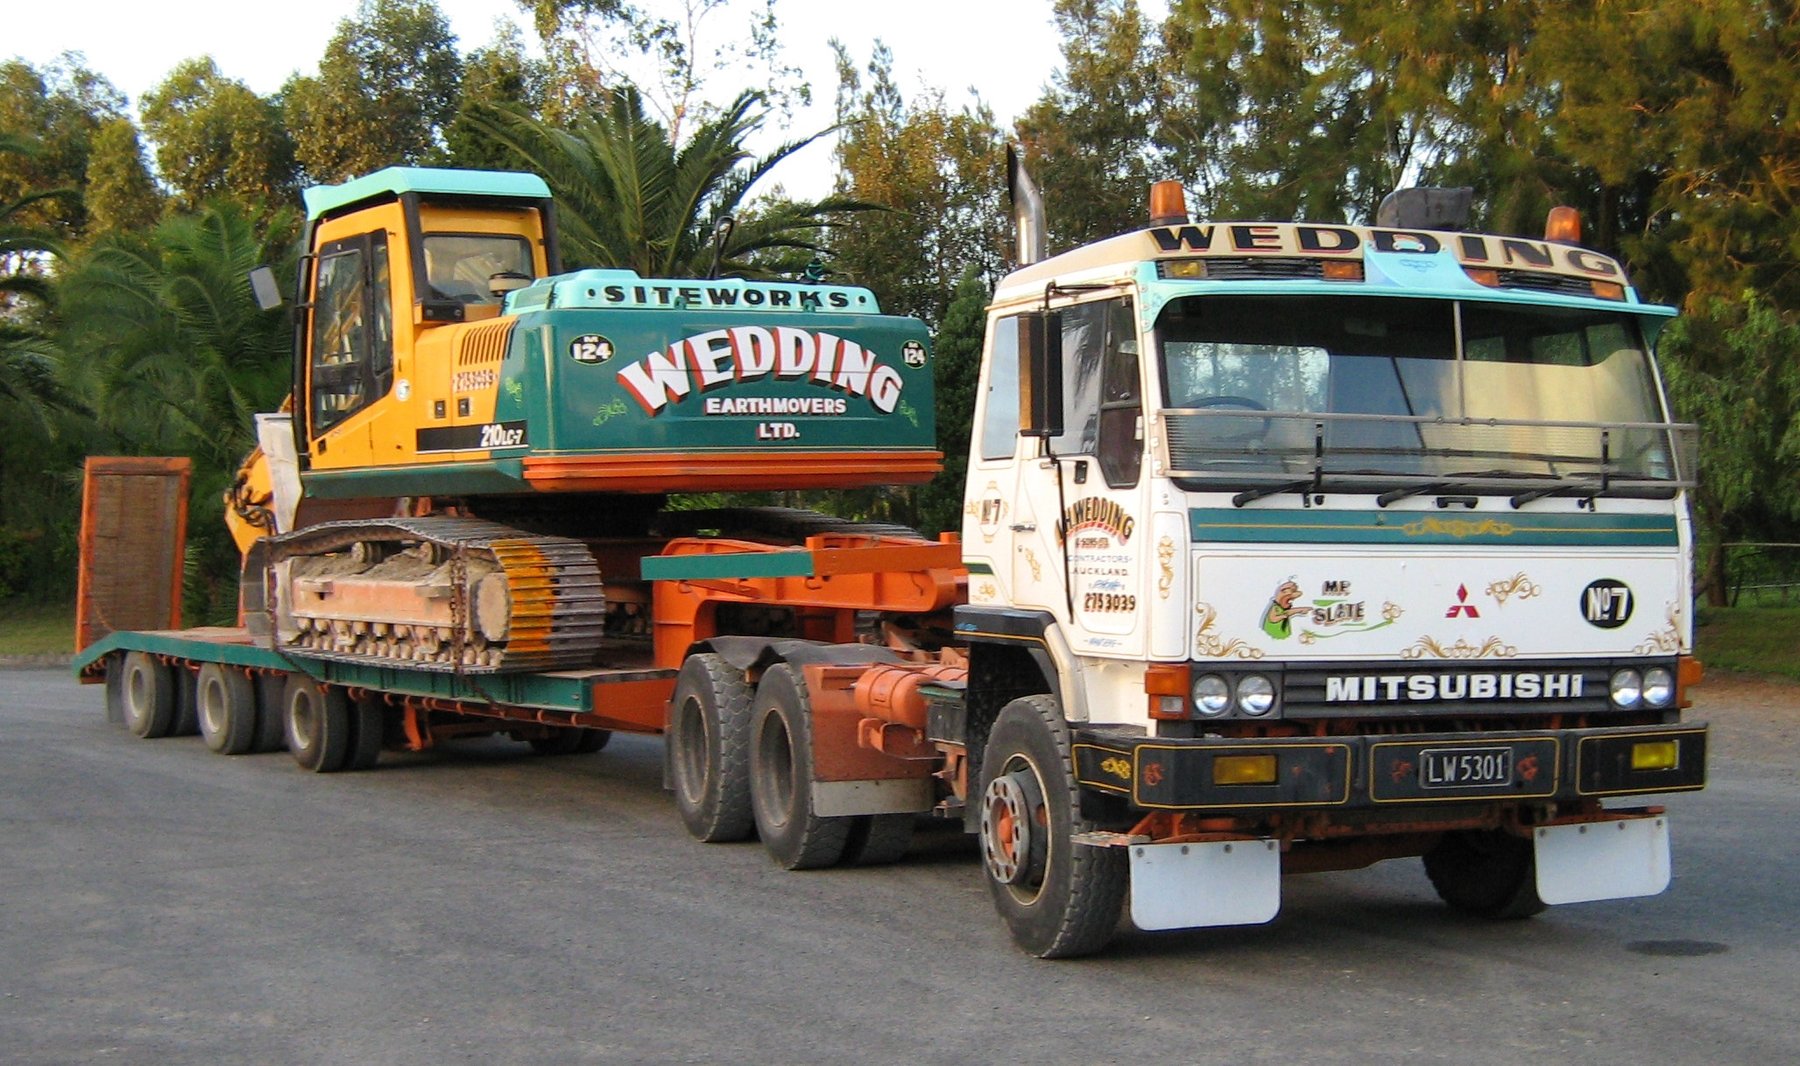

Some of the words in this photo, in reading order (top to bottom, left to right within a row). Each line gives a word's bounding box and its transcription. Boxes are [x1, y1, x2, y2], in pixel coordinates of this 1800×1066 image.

[1150, 224, 1618, 277] WEDDING
[604, 284, 850, 308] SITEWORKS
[573, 342, 612, 360] 124
[903, 347, 925, 364] 124
[617, 325, 904, 416] WEDDING
[704, 397, 847, 416] EARTHMOVERS
[758, 423, 801, 440] LTD.
[1312, 601, 1366, 626] SLATE
[1326, 673, 1583, 702] MITSUBISHI
